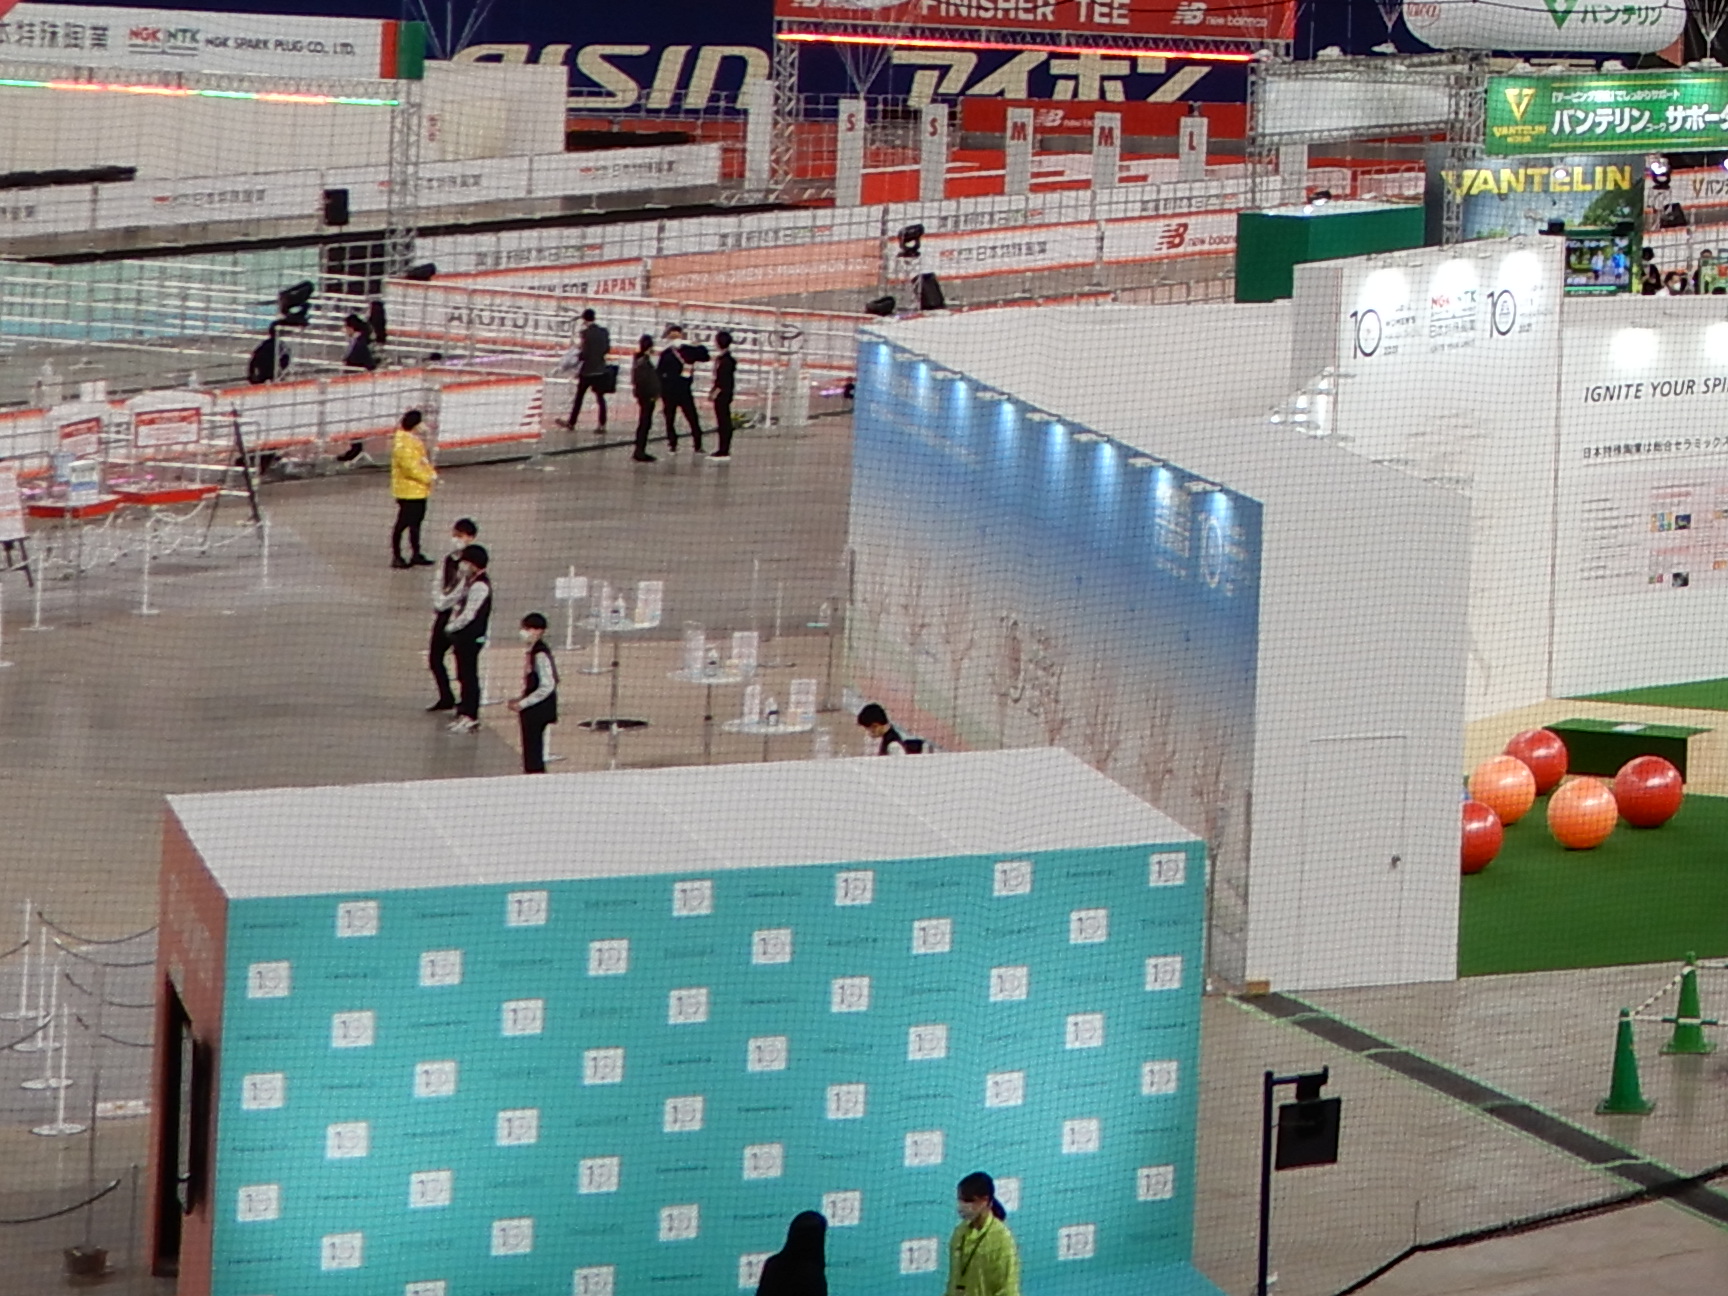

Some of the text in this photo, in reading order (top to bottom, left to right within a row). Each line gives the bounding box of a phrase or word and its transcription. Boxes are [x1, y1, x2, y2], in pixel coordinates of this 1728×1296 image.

[234, 37, 272, 51] SPARK
[274, 39, 303, 53] PLUG
[1442, 163, 1633, 197] VANTELIN
[594, 276, 637, 296] JAPAN
[1584, 381, 1645, 405] IGNITE
[1650, 376, 1697, 399] YOUR
